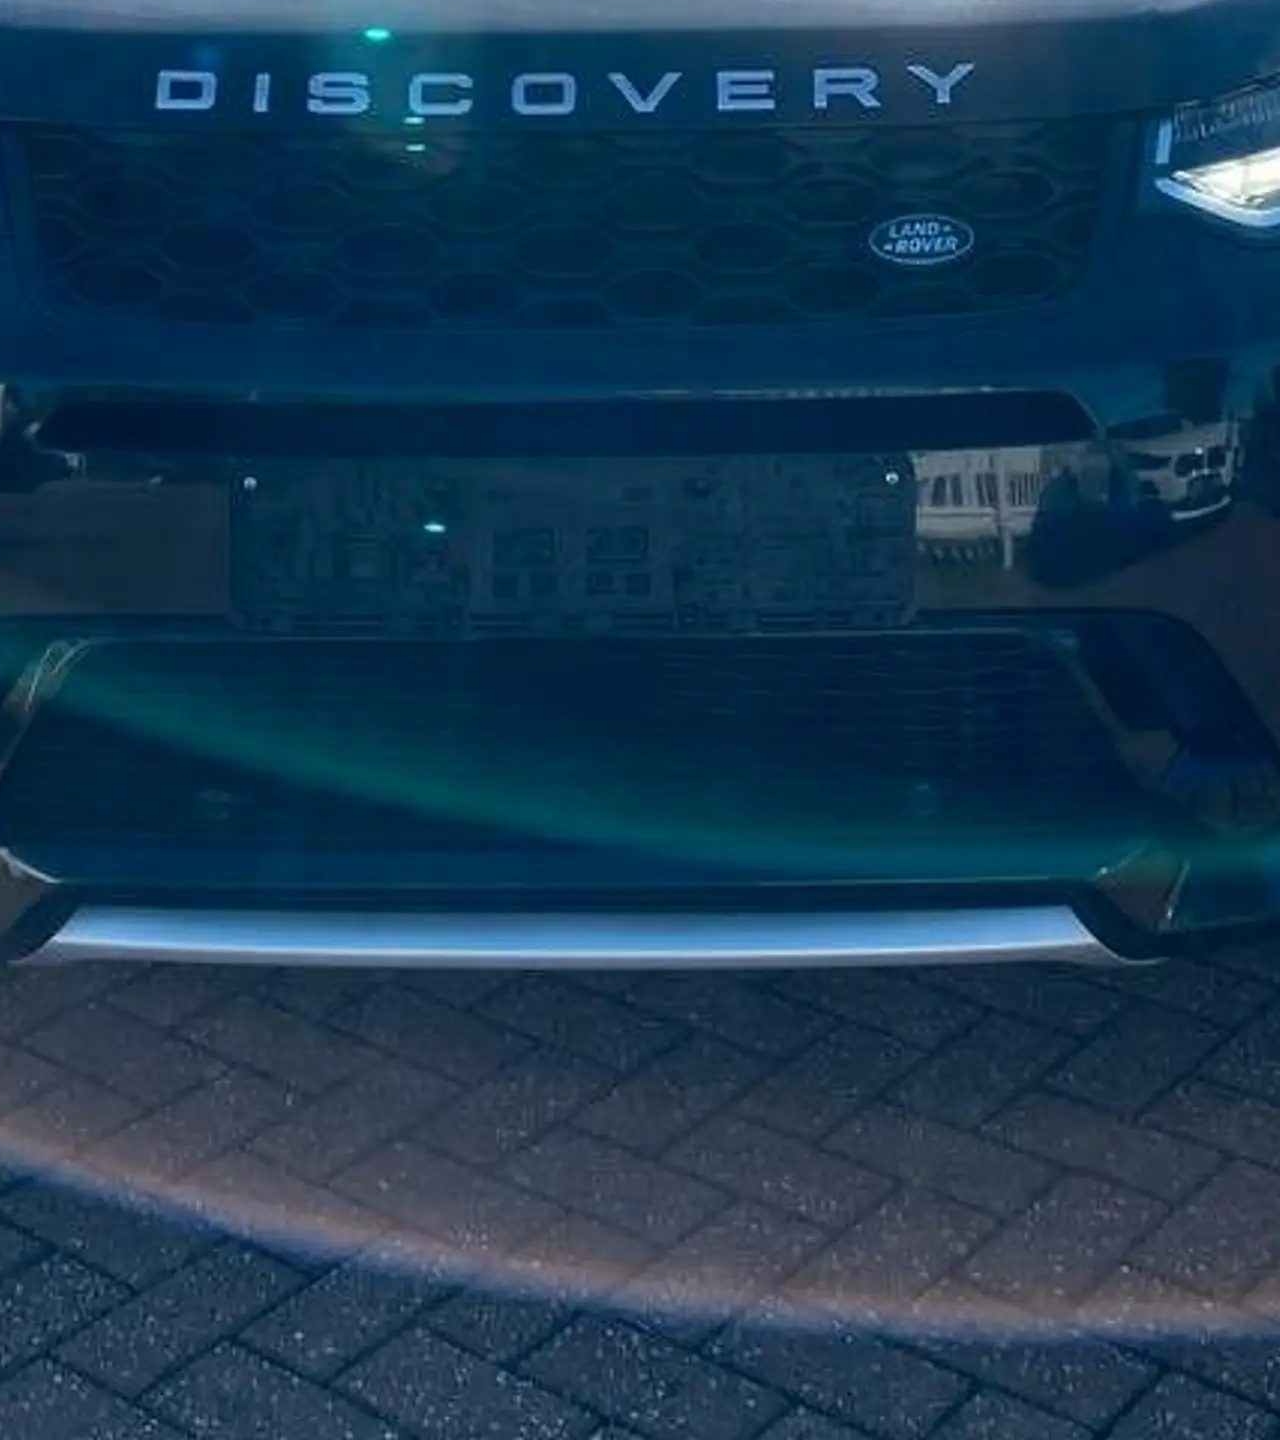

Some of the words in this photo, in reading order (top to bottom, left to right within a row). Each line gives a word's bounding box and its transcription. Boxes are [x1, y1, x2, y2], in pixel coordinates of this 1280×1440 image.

[154, 62, 976, 116] DISCOVERY
[888, 221, 939, 239] LAND
[895, 235, 959, 254] ROVER
